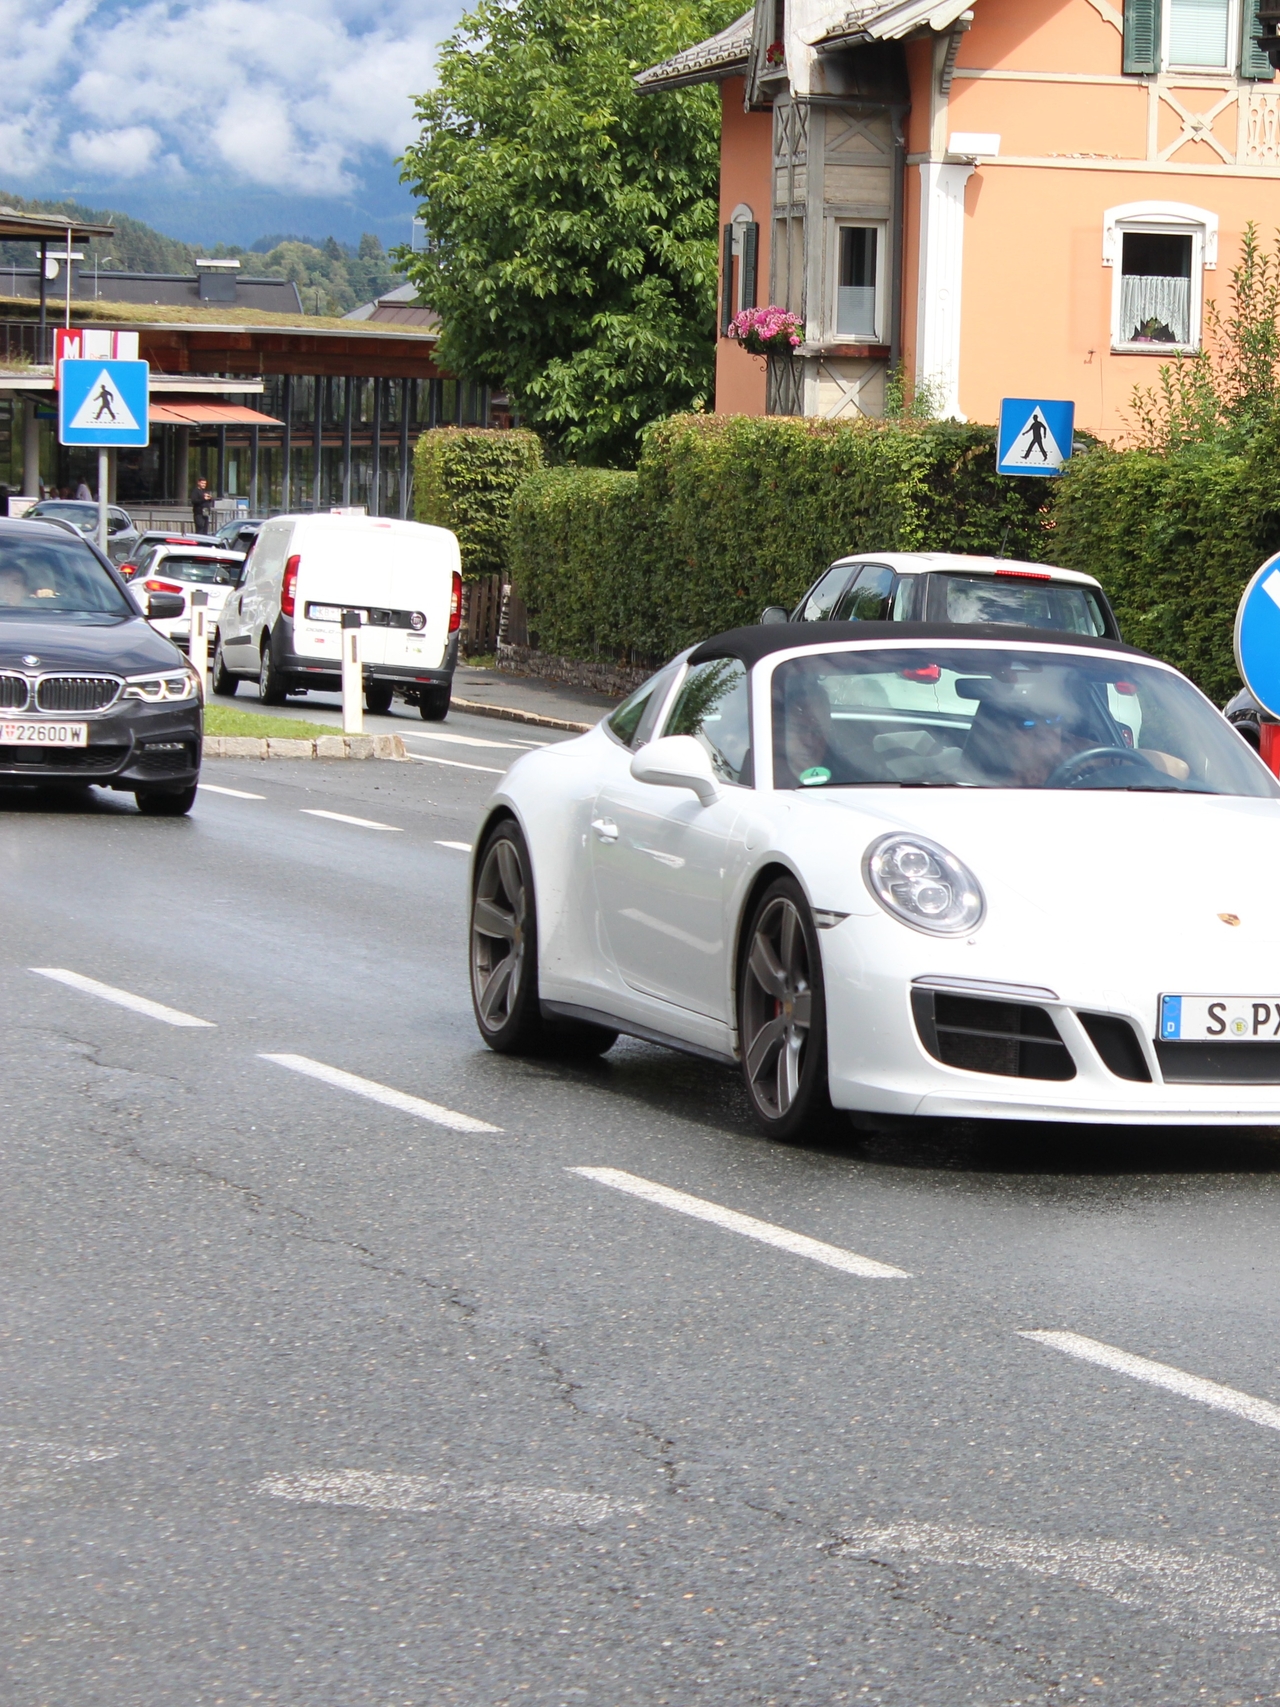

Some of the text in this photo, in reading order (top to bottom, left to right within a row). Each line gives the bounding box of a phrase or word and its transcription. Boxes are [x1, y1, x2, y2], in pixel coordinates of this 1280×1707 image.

[16, 725, 66, 742] 22600
[71, 726, 82, 742] W
[1167, 1022, 1175, 1032] D
[1206, 1002, 1227, 1036] S
